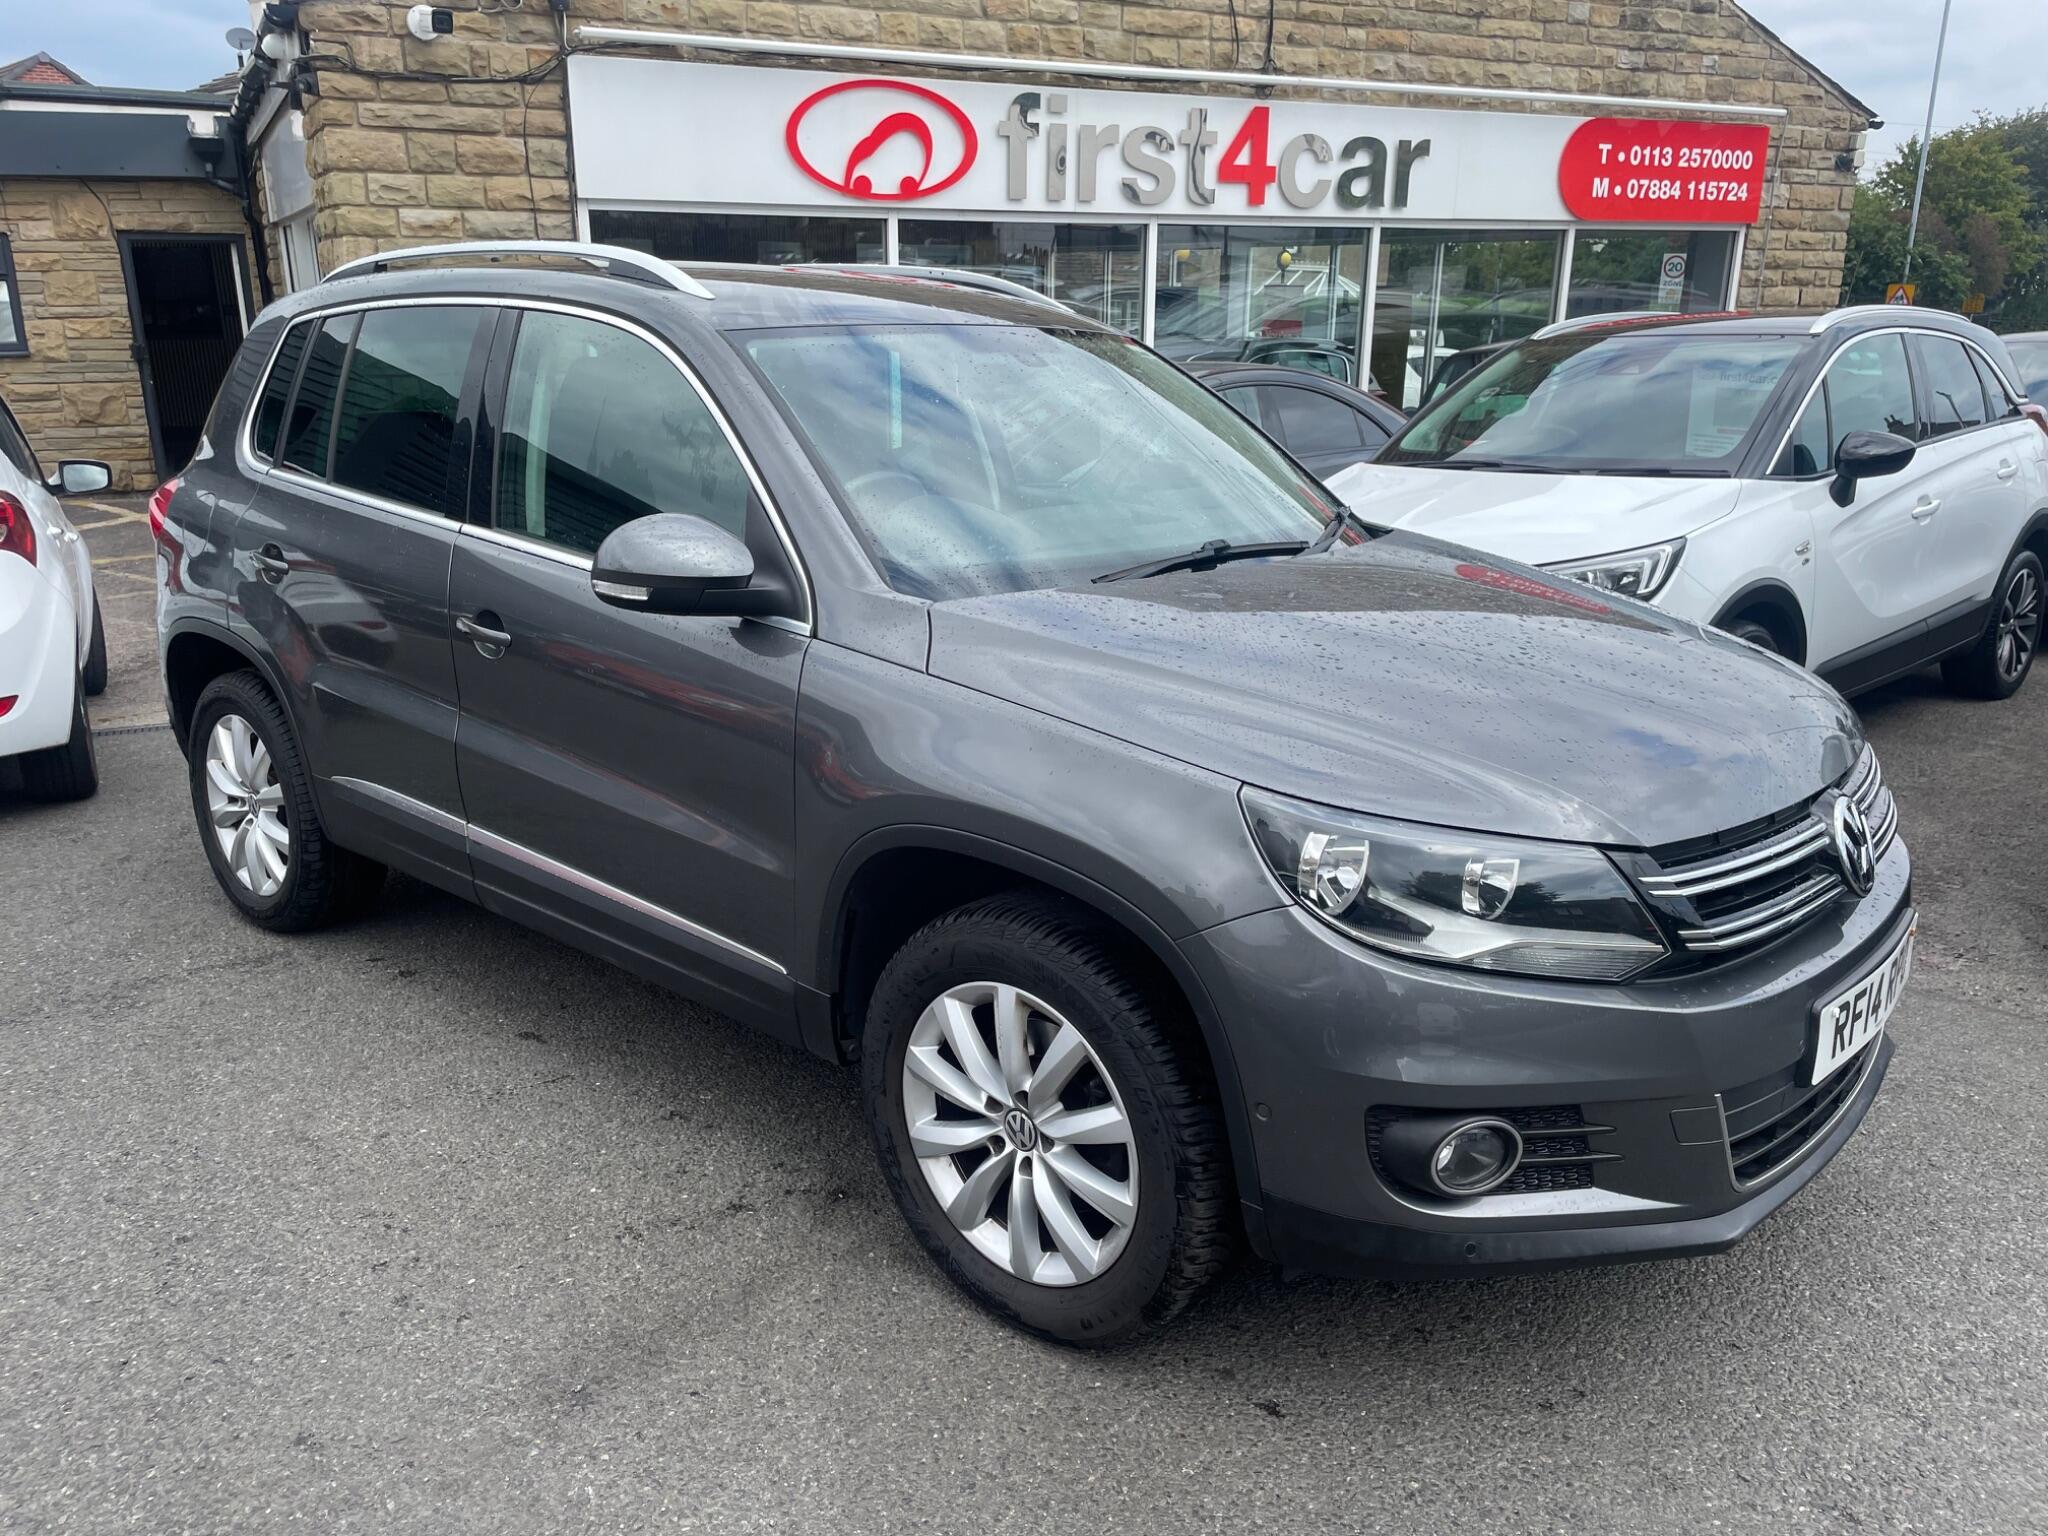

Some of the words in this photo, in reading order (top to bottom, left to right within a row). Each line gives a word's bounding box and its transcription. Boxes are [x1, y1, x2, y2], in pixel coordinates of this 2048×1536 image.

[999, 92, 1431, 209] first4car
[1599, 143, 1612, 164] T
[1630, 145, 1673, 167] 0113
[1678, 147, 1753, 170] 2570000
[1591, 177, 1610, 198] M
[1626, 178, 1681, 199] 07884
[1687, 180, 1748, 202] 115724
[1667, 261, 1683, 272] 20
[1831, 972, 1885, 1060] RF14
